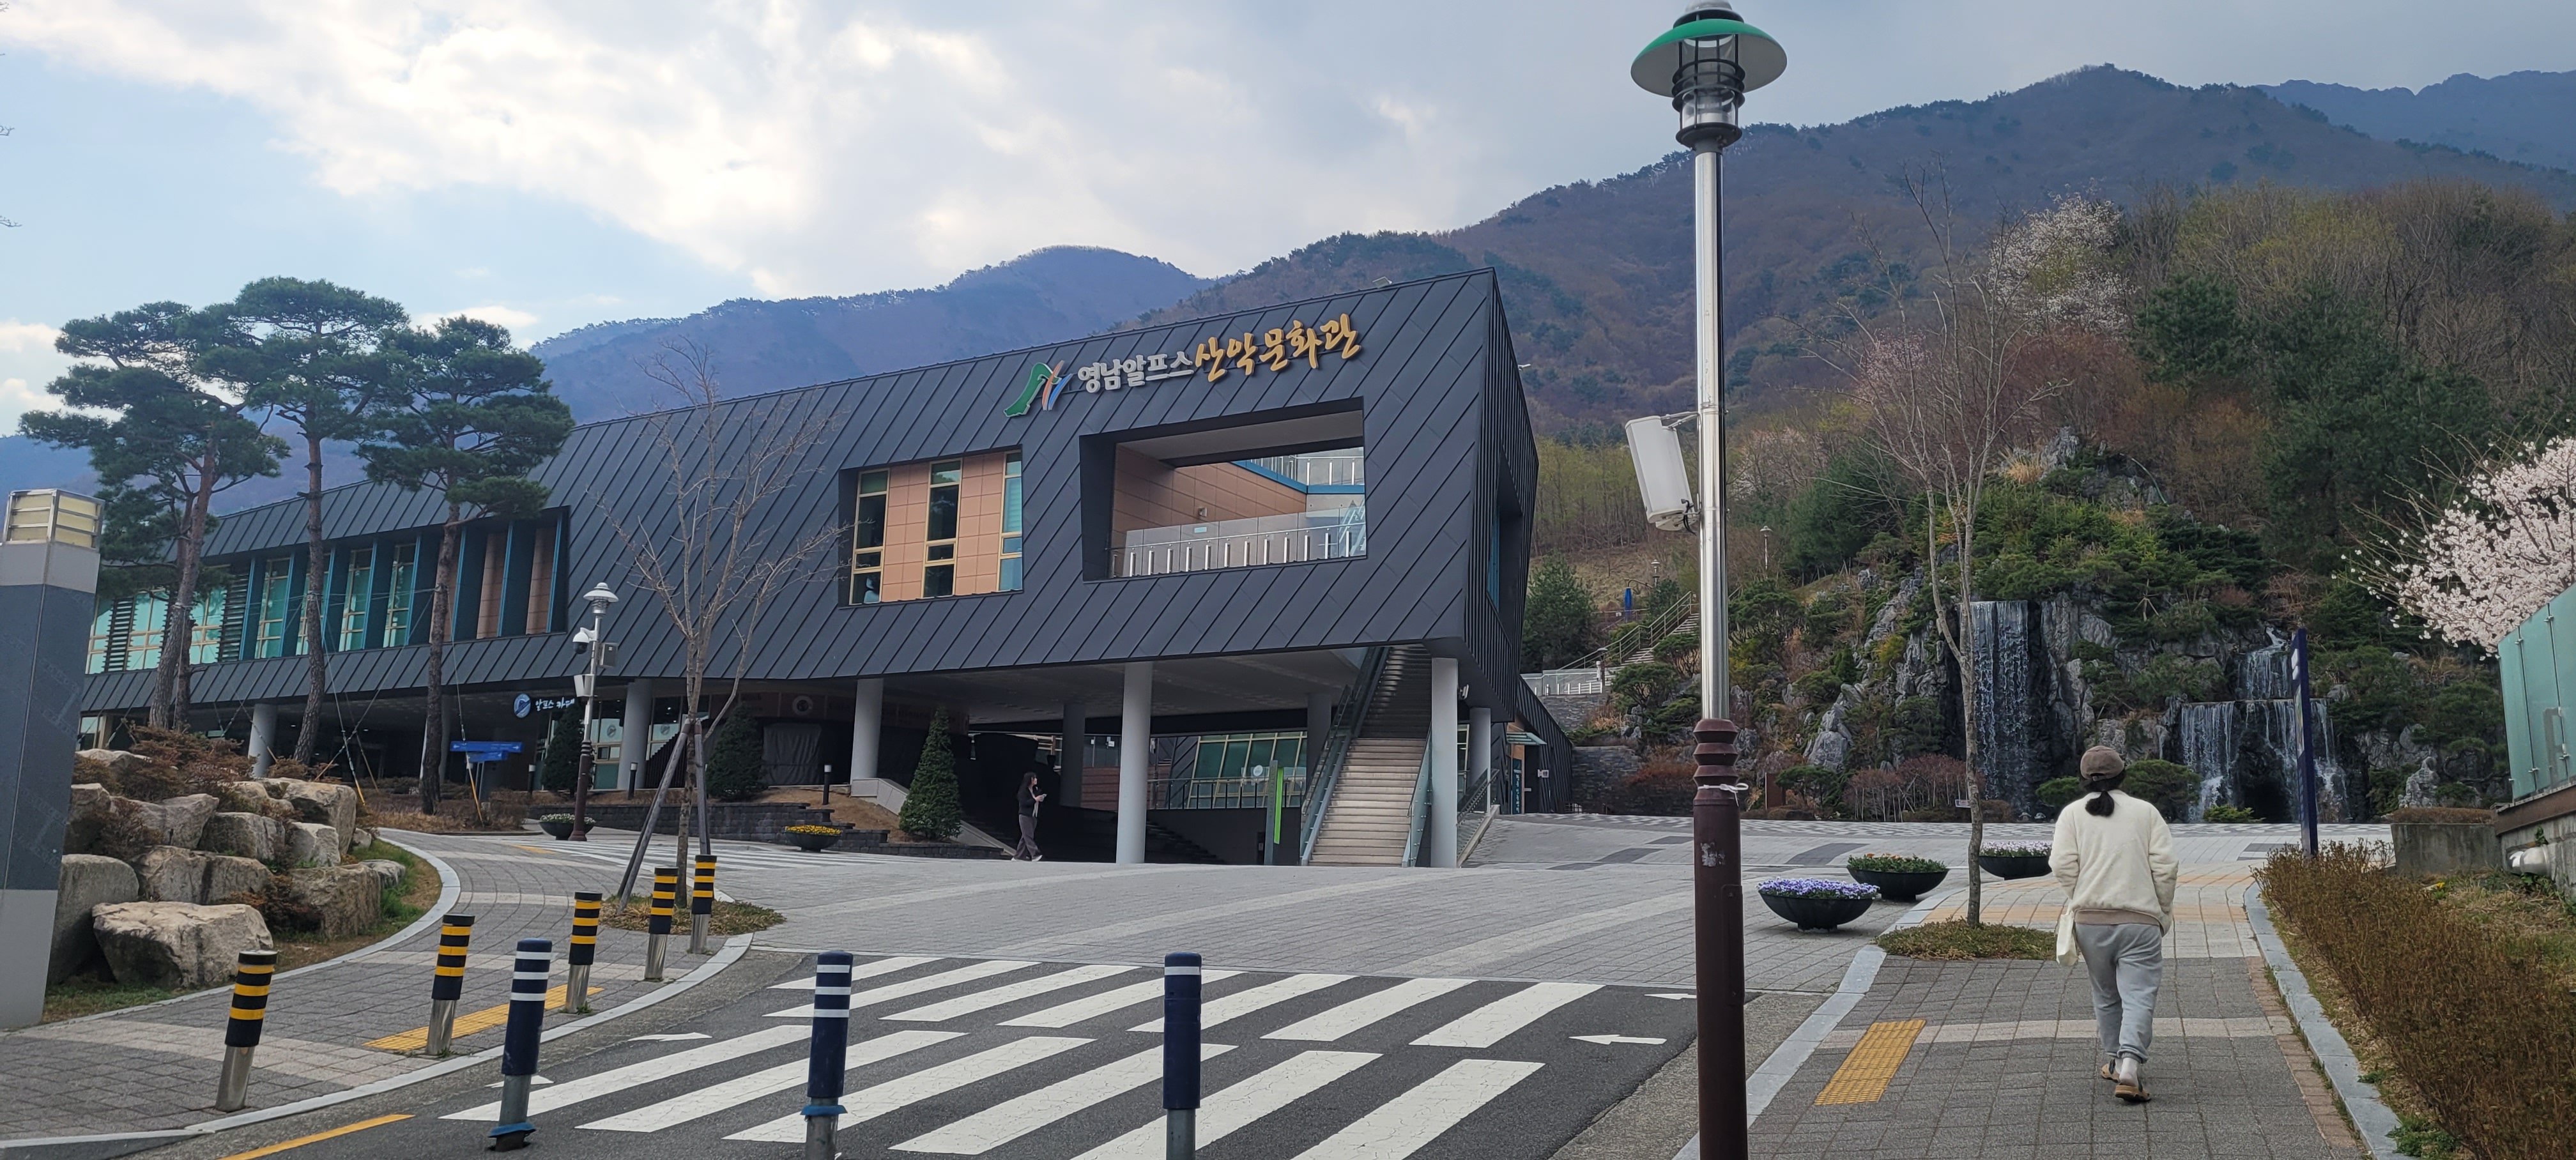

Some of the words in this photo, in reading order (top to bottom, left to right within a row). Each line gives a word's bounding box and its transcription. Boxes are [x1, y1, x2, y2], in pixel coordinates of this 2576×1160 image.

[1078, 351, 1193, 392] 영남알프스
[1195, 313, 1361, 382] 산악문화관
[535, 699, 554, 711] 알프스
